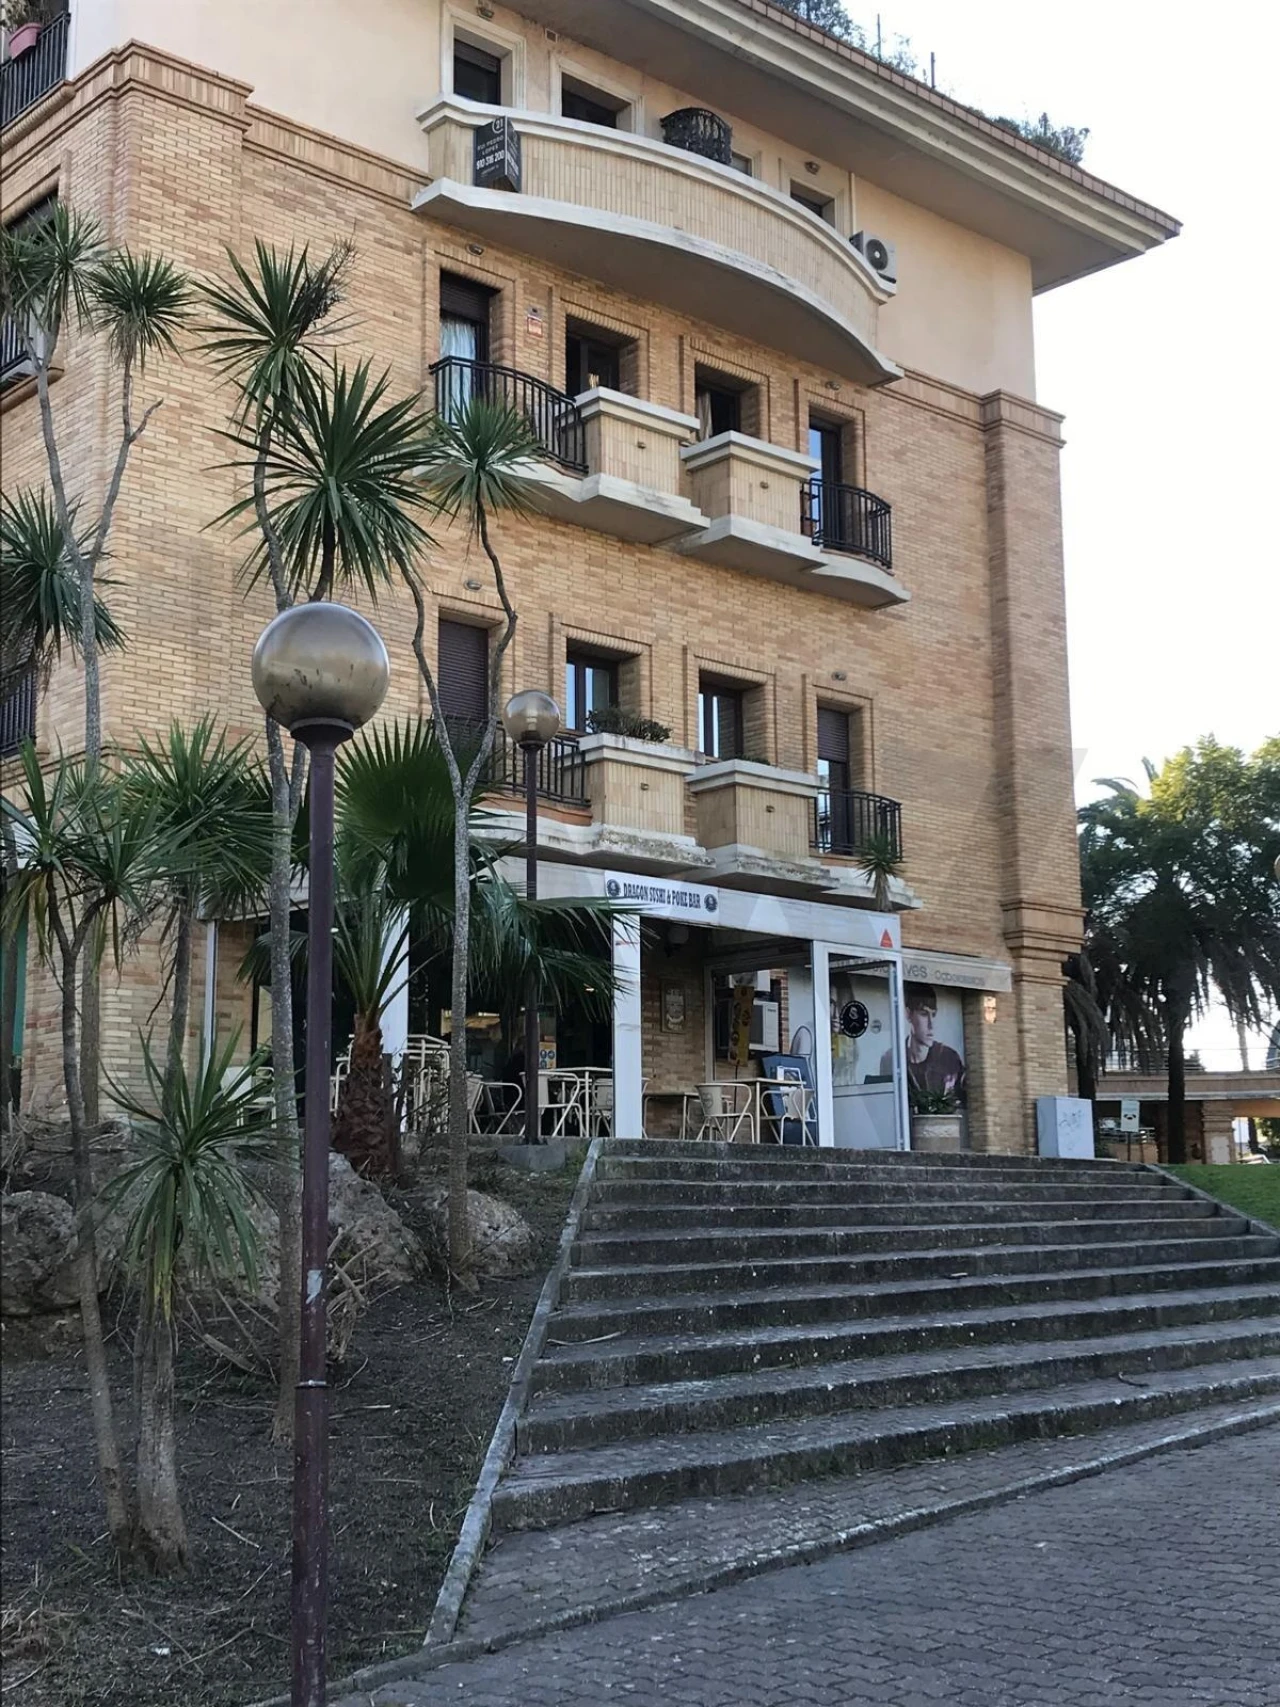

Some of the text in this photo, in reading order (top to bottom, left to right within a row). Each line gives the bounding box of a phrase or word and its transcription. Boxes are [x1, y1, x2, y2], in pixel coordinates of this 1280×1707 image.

[623, 882, 650, 901] DRAGON
[649, 887, 666, 904] SUSHI
[666, 890, 672, 905] &
[672, 890, 688, 907] POKE
[688, 894, 701, 908] BAR
